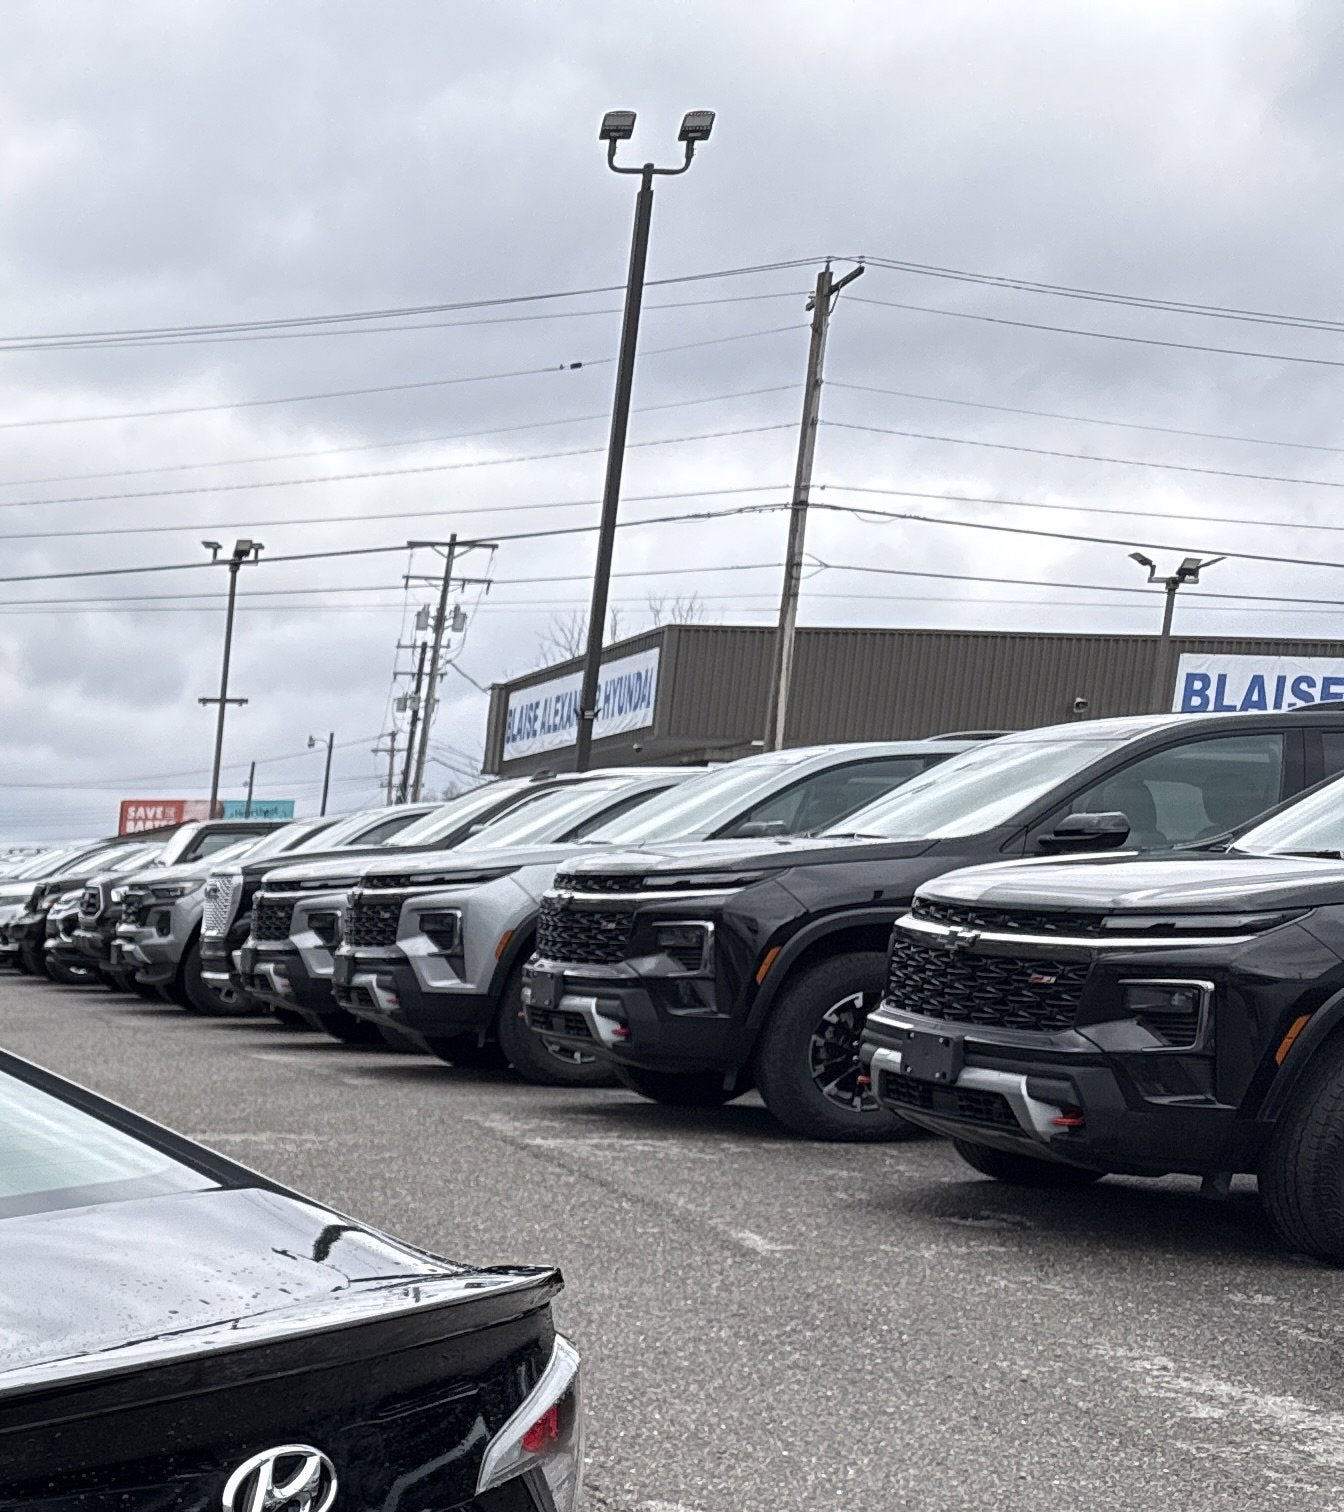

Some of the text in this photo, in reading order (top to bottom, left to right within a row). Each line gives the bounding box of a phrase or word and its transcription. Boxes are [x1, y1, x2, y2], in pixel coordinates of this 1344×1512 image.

[506, 700, 541, 744] BLAISE
[602, 667, 654, 721] HYUNDAI
[1181, 672, 1344, 713] BLAISE
[127, 805, 164, 819] SAVE
